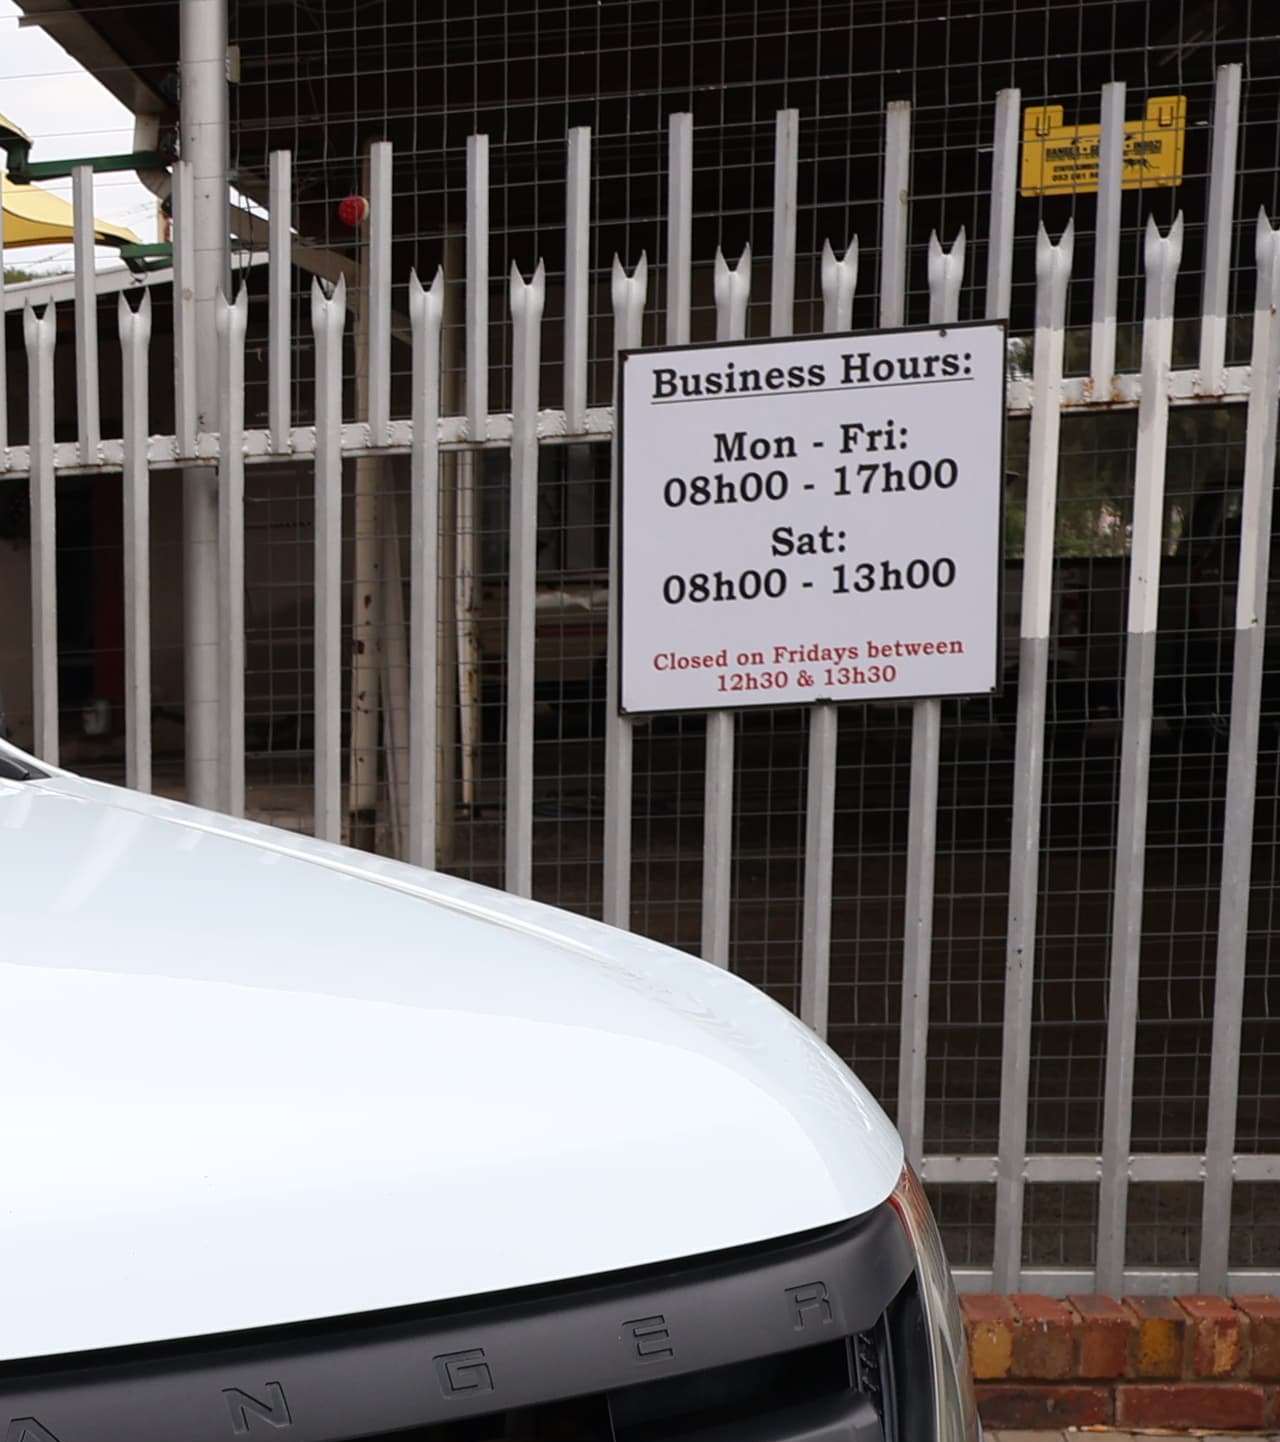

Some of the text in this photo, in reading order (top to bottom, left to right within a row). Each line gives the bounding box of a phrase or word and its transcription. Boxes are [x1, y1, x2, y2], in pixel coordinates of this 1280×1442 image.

[652, 351, 974, 399] Business Hours:
[714, 431, 797, 463] Mon
[840, 419, 908, 454] Fri:
[663, 470, 789, 508] 08h00
[834, 457, 959, 496] 17h00
[771, 525, 846, 557] Sat:
[662, 568, 787, 604] 08h00
[832, 558, 957, 594] 13h00
[653, 638, 964, 672] Closed on Fridays between
[717, 665, 897, 692] 12h30 & 13h30
